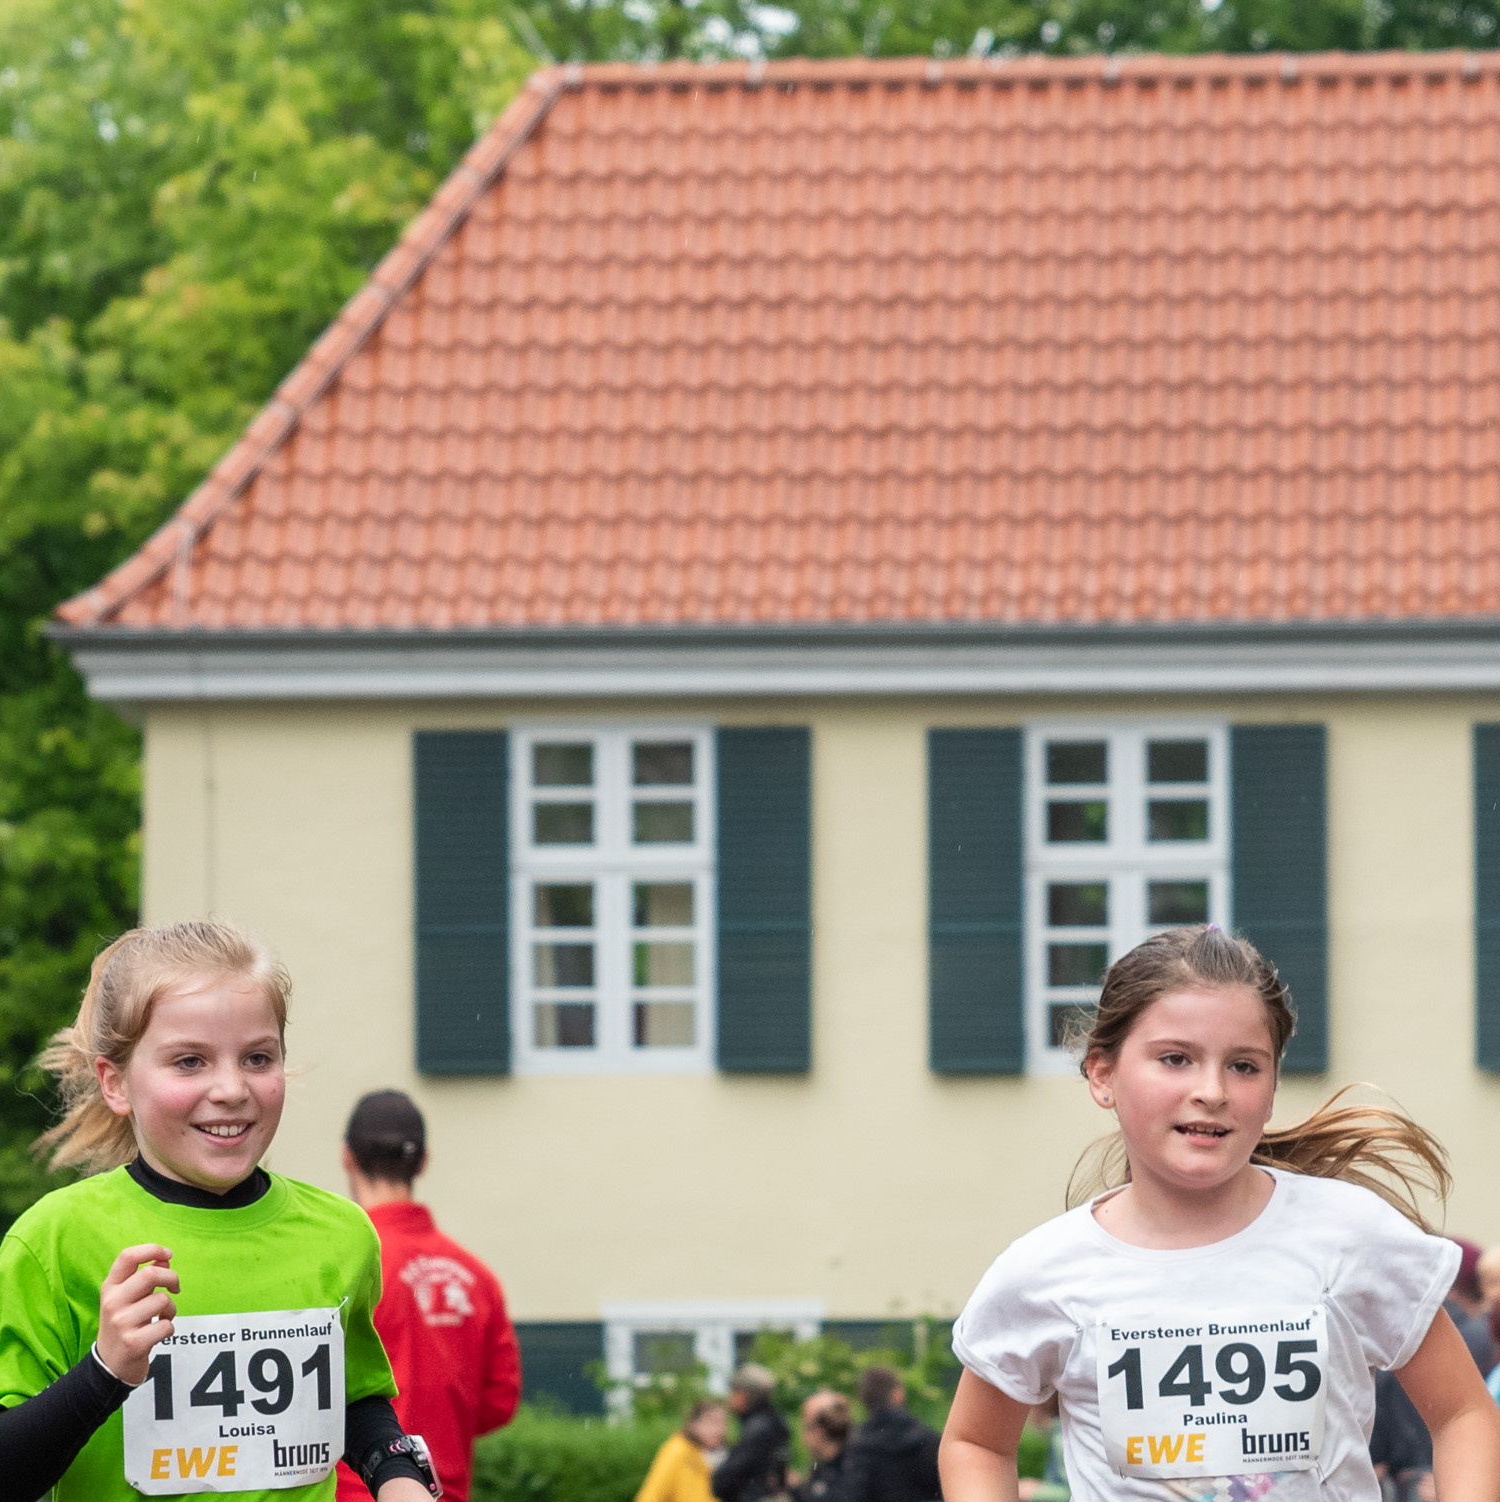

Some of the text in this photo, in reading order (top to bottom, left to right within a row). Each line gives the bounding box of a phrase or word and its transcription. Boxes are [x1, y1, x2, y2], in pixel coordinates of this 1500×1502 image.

[161, 1322, 333, 1346] erstener Brunnenlauf
[1111, 1319, 1311, 1341] Everstener Brunnenlauf
[146, 1343, 332, 1421] 1491
[1107, 1339, 1322, 1411] 1495
[218, 1422, 276, 1438] Louisa
[1183, 1412, 1249, 1426] Paulina
[272, 1438, 330, 1468] bruns
[1125, 1433, 1207, 1465] EWE
[1241, 1427, 1310, 1455] bruns
[150, 1445, 239, 1480] EWE
